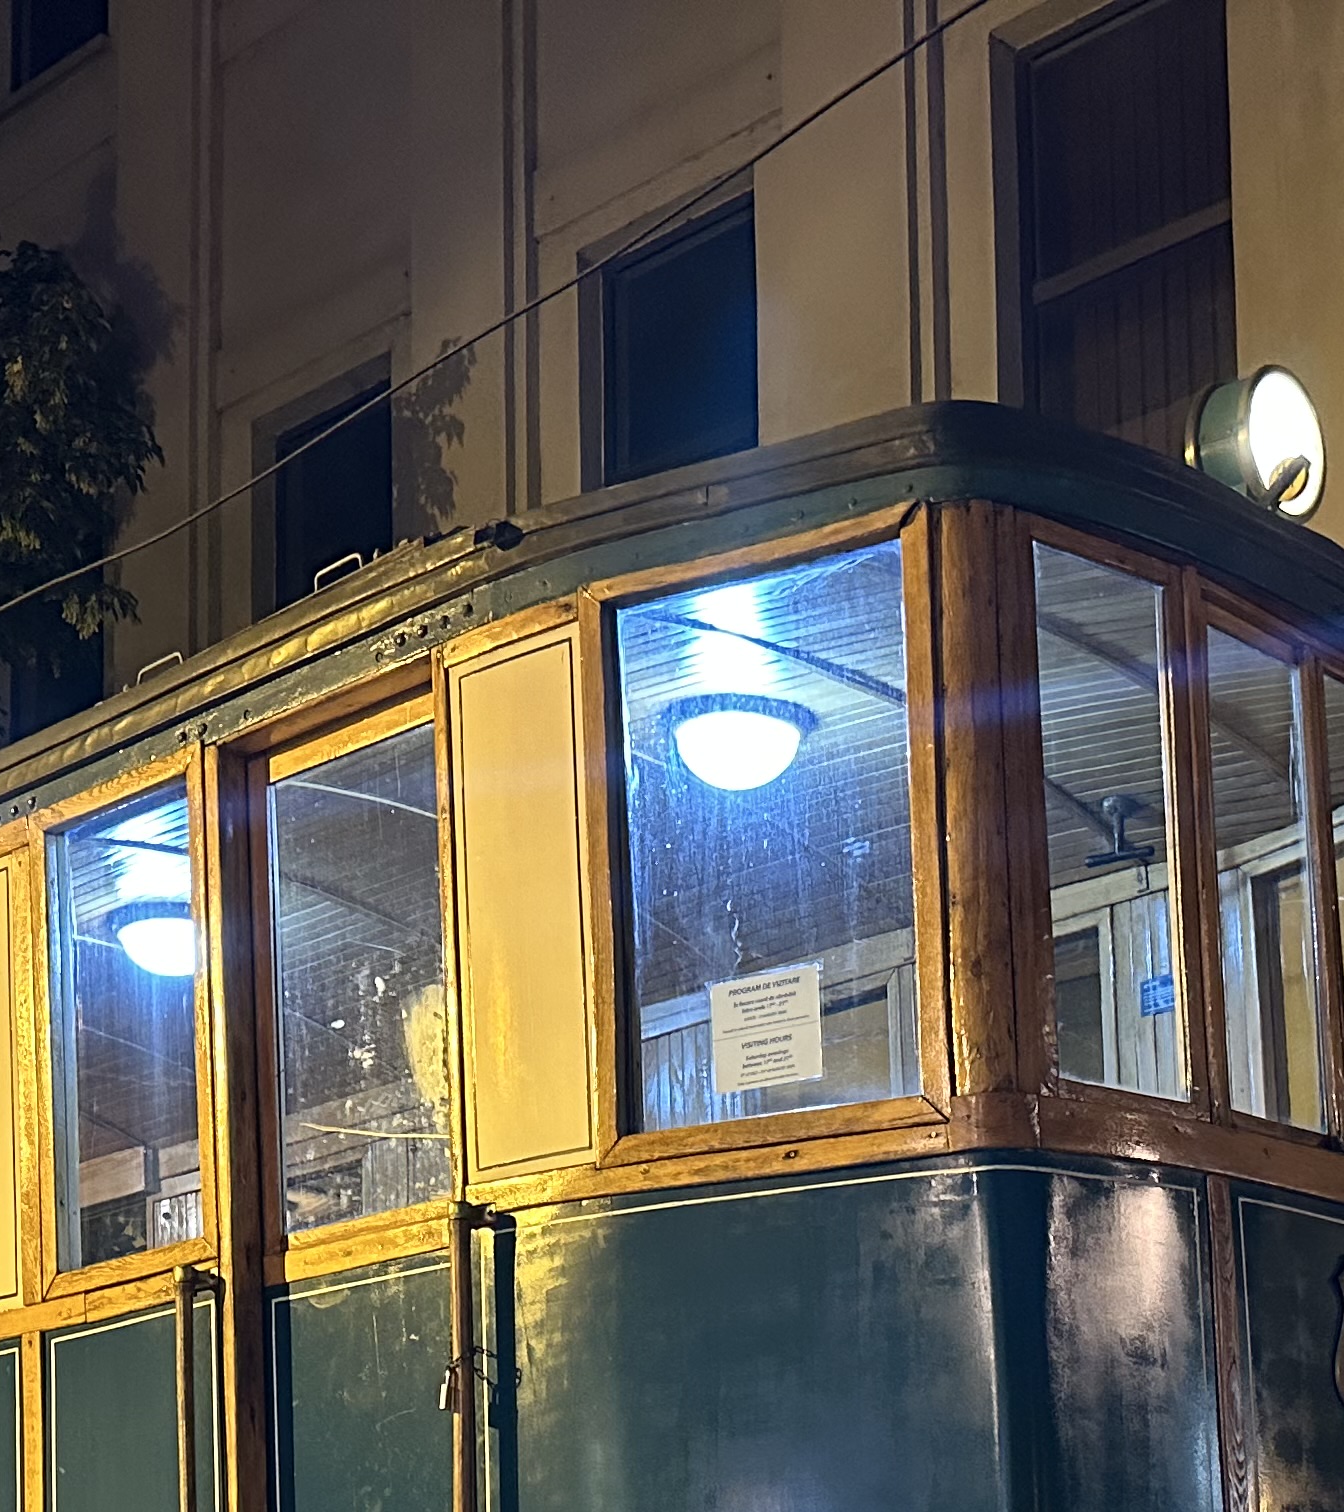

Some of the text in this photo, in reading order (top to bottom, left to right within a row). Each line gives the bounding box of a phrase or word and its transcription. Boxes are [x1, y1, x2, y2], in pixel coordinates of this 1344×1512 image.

[728, 983, 761, 997] PROGRAM
[762, 982, 771, 991] DE
[741, 1033, 792, 1049] VISITING HOURS
